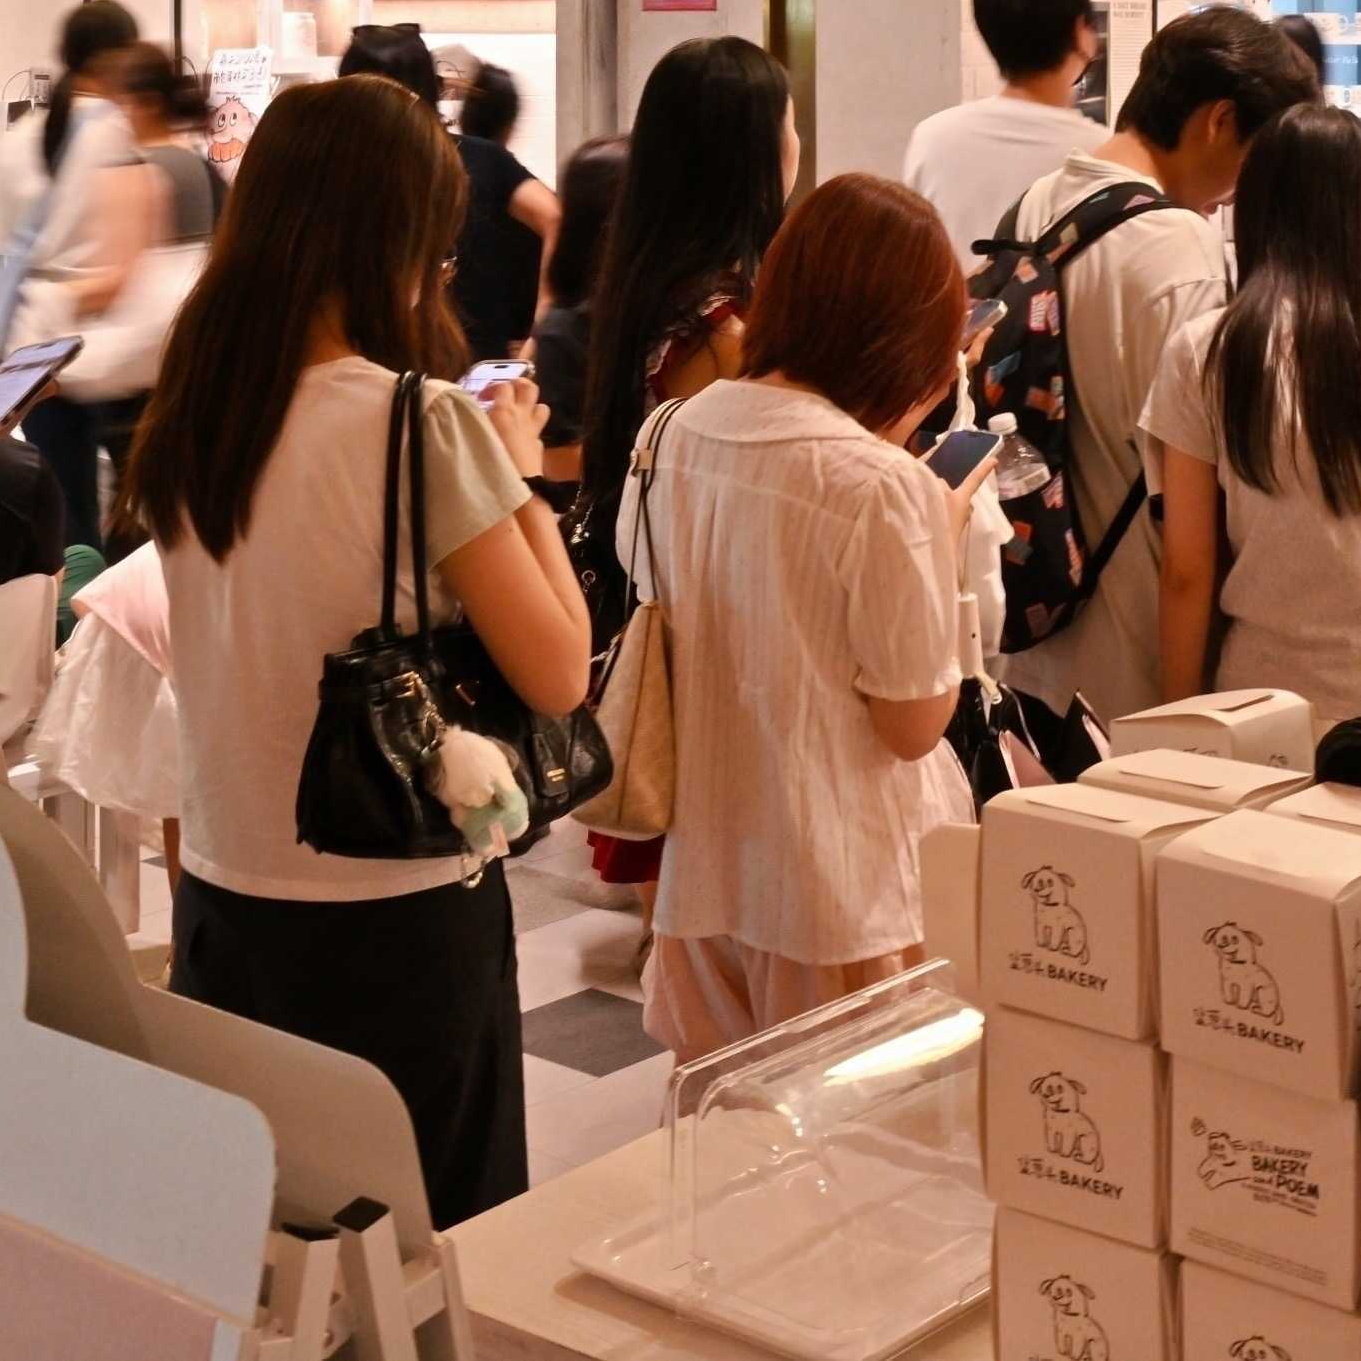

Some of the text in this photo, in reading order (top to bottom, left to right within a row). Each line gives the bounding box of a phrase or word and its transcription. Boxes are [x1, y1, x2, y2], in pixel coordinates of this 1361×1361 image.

[1047, 963, 1108, 992] BAKERY
[1236, 1023, 1306, 1054] BAKERY
[1251, 1155, 1309, 1178] BAKERY
[1059, 1171, 1124, 1200] BAKERY
[1275, 1174, 1320, 1200] POEM
